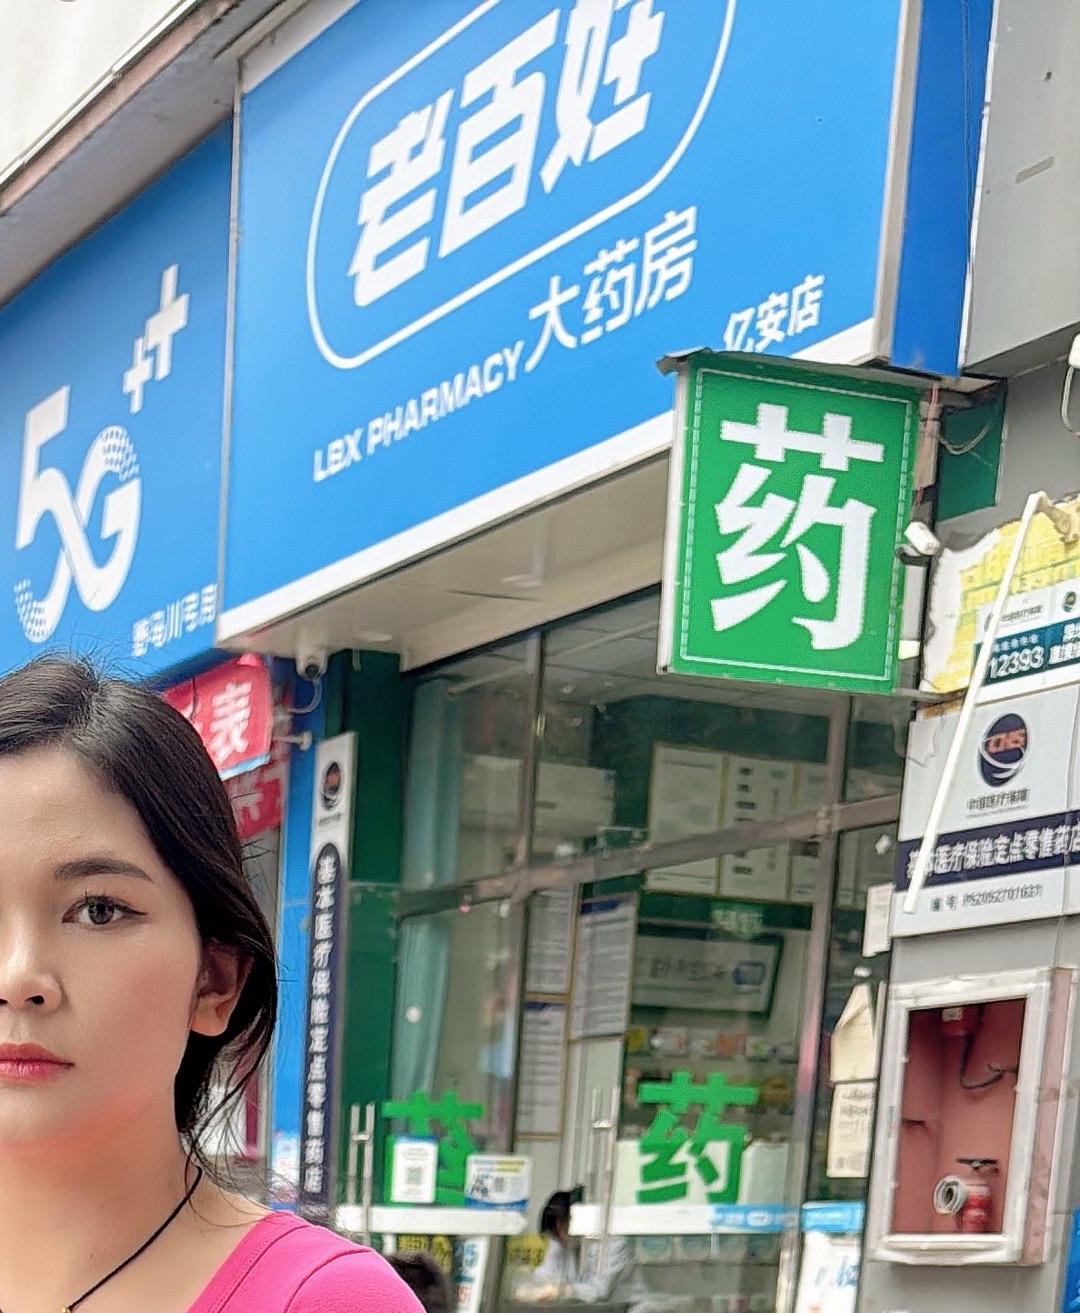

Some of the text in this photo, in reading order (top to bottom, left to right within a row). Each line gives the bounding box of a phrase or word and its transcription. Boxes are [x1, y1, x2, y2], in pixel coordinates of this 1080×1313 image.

[349, 0, 664, 307] 老百姓
[526, 206, 698, 373] 大药房
[723, 274, 825, 352] 亿安店
[313, 340, 525, 482] LBX PHARMACY
[710, 402, 885, 650] 药
[989, 646, 1044, 678] 12393
[638, 1071, 758, 1203] 药
